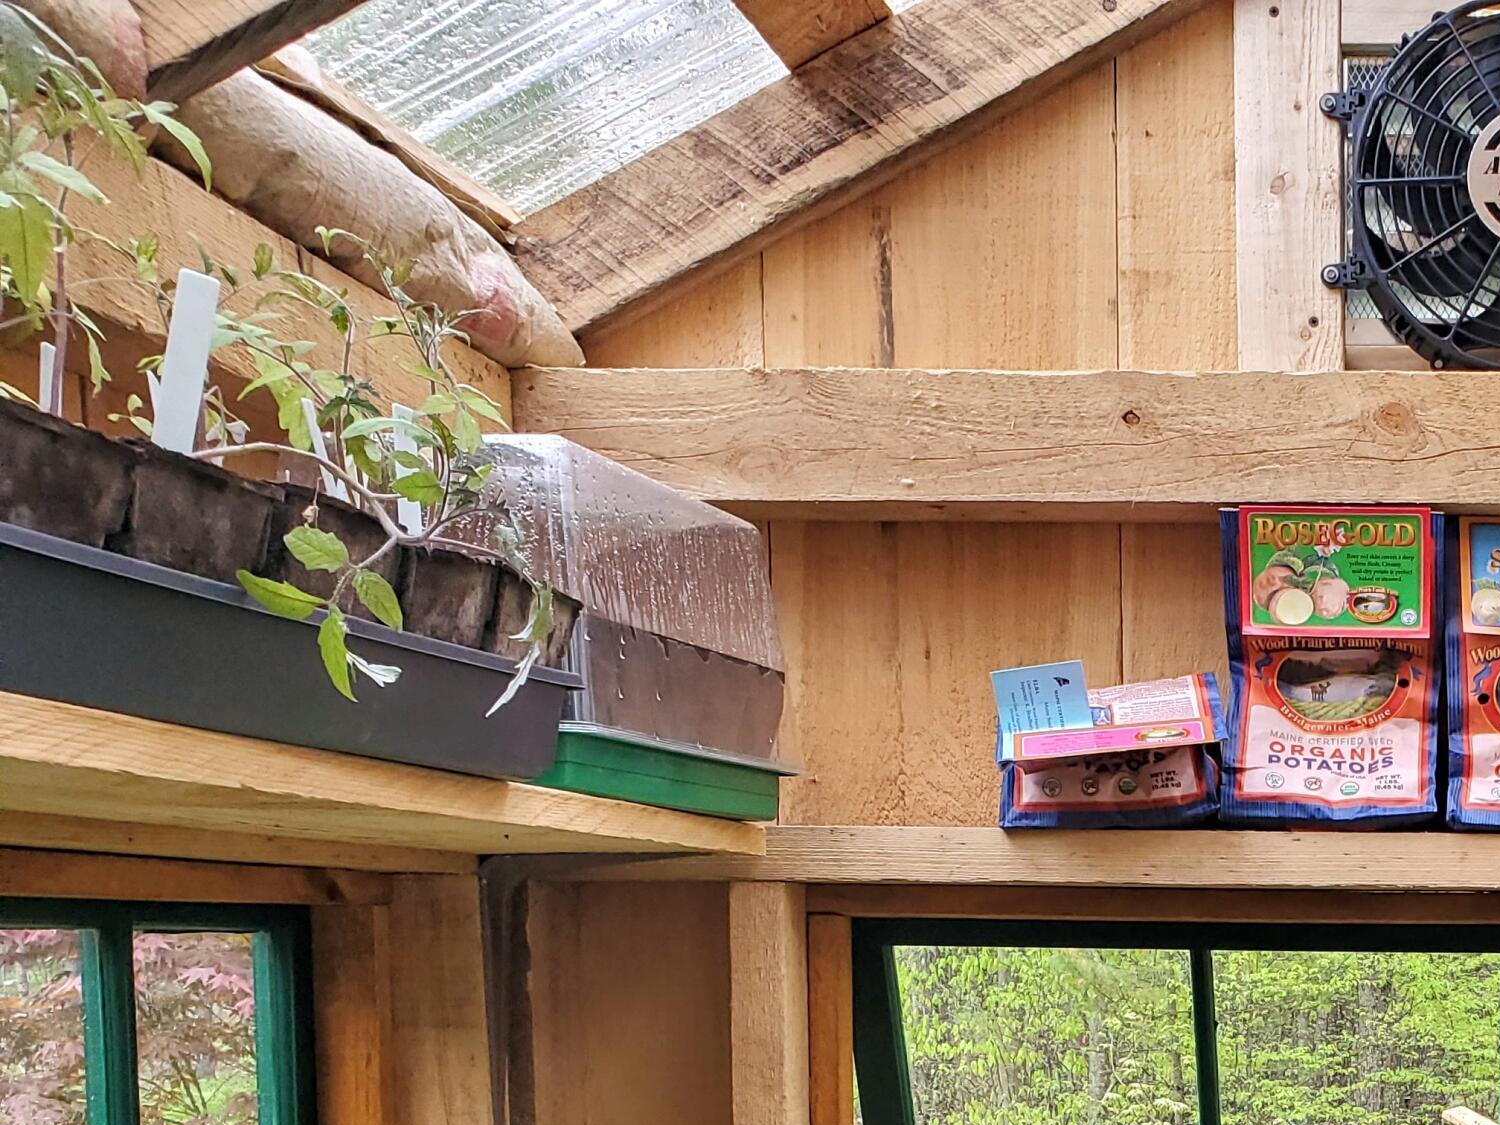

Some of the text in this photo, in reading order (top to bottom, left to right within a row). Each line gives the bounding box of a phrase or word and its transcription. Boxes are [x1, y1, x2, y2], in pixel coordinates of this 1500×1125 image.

[1251, 637, 1289, 650] Wood
[1292, 637, 1336, 650] Prairie
[1338, 637, 1383, 651] Family
[1269, 729, 1303, 744] MAINE
[1308, 737, 1364, 748] CERTIFIED
[1269, 741, 1393, 762] ORGANIC
[1268, 754, 1393, 775] POTATOES
